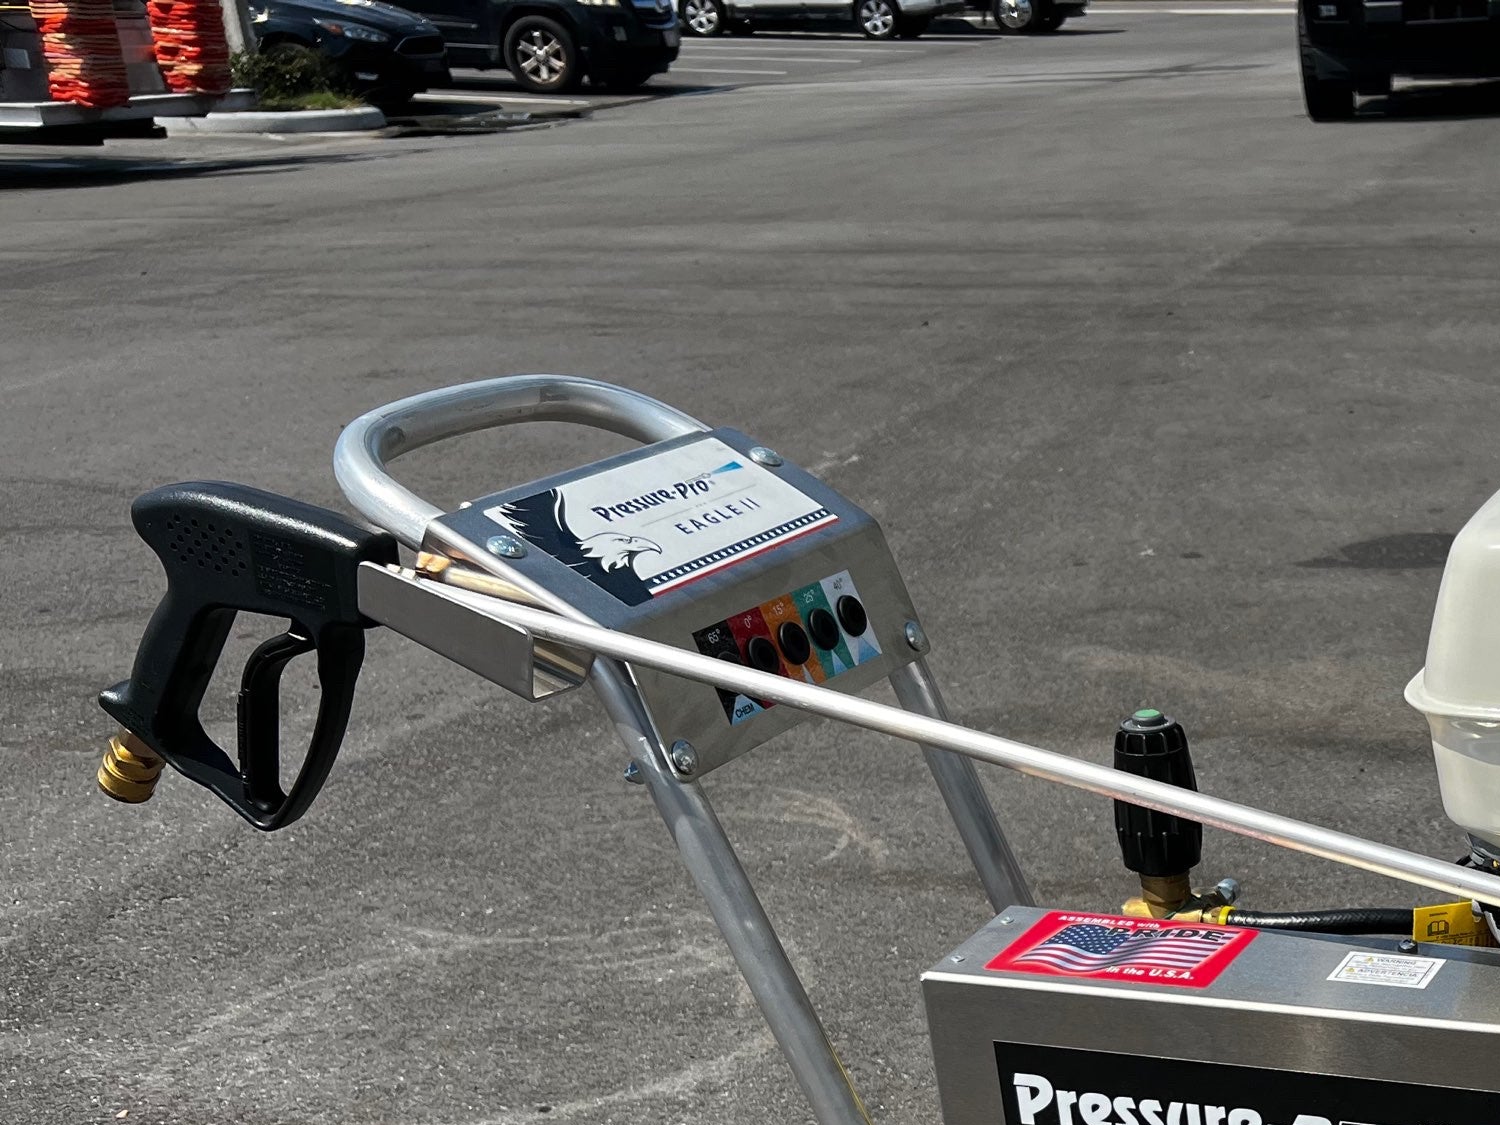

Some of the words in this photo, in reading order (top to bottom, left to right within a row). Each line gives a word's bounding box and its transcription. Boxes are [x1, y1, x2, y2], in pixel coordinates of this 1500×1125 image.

[675, 504, 743, 535] EAGLE
[735, 702, 755, 719] CHEM
[1057, 914, 1135, 928] ASSEMBLED
[1136, 921, 1161, 929] with
[1105, 926, 1226, 942] PRIDE
[1124, 967, 1144, 976] the
[1149, 969, 1195, 980] U.S.A.
